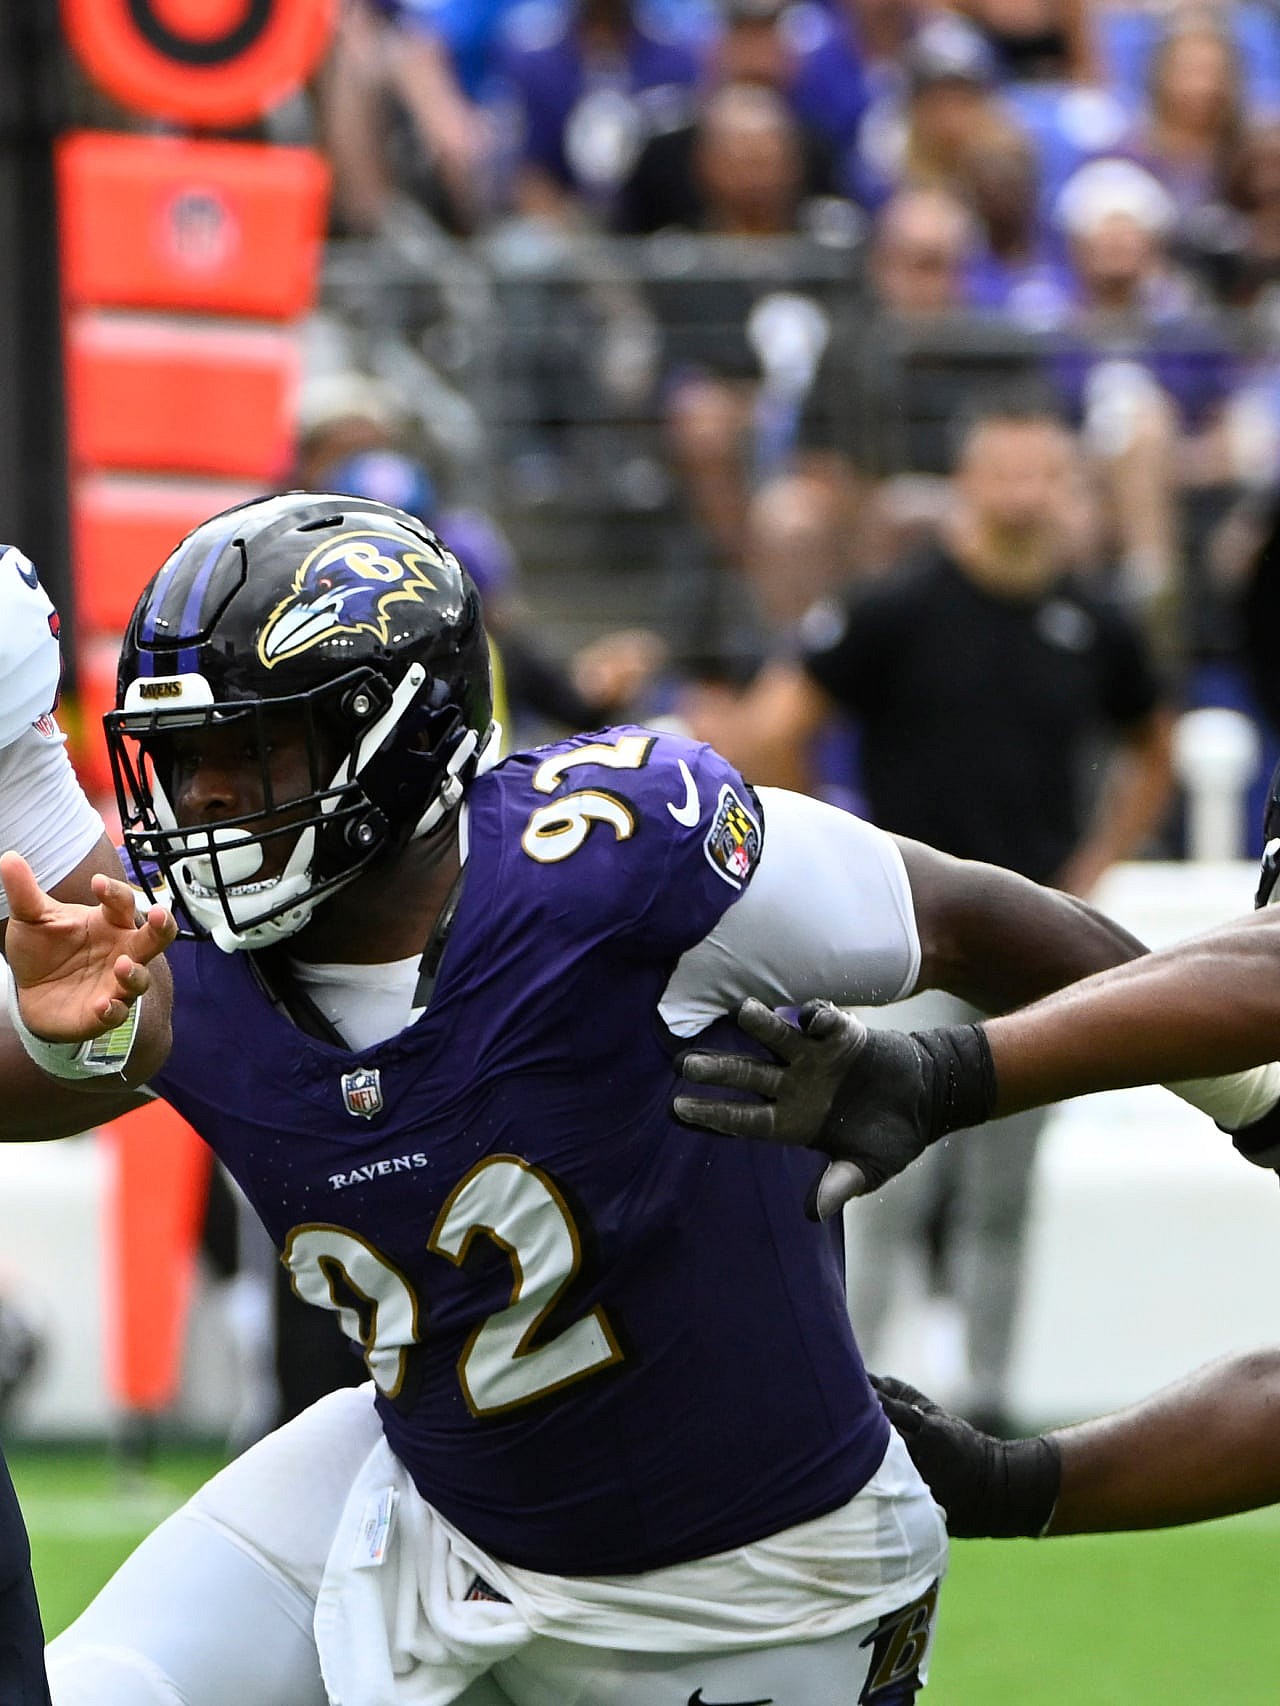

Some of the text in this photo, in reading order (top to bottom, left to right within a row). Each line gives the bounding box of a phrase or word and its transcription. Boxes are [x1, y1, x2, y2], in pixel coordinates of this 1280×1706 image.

[521, 736, 658, 864] 92
[349, 1090, 378, 1110] NFL
[328, 1153, 428, 1190] RAVENS
